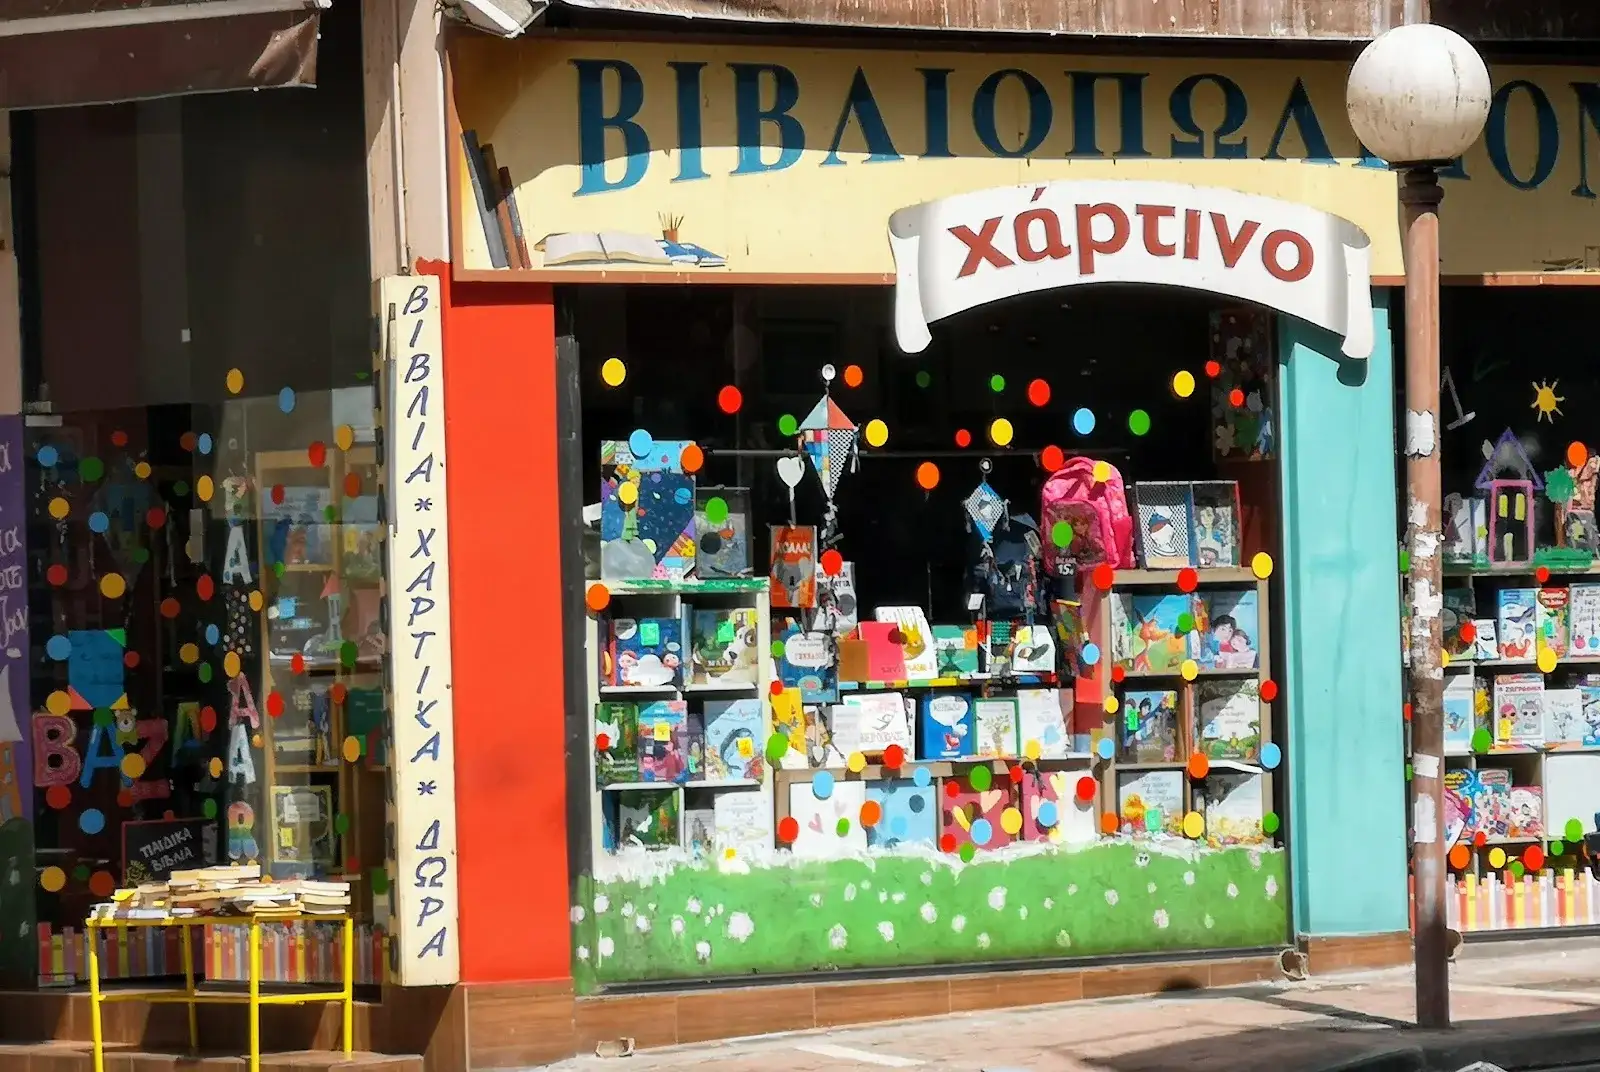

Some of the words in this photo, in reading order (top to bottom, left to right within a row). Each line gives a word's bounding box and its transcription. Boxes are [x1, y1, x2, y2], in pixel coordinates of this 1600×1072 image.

[569, 57, 1600, 198] ΒΙΒΛΙΟΠΩΛΟ
[946, 186, 1314, 283] χάρτινο
[402, 284, 433, 484] ΒΙΒΛΙΑ
[405, 527, 441, 763] ΧΑΡΤΙΚΑ
[139, 827, 193, 858] ΠΑΙΔΙΚΑ
[414, 819, 448, 959] ΔΩΡΑ
